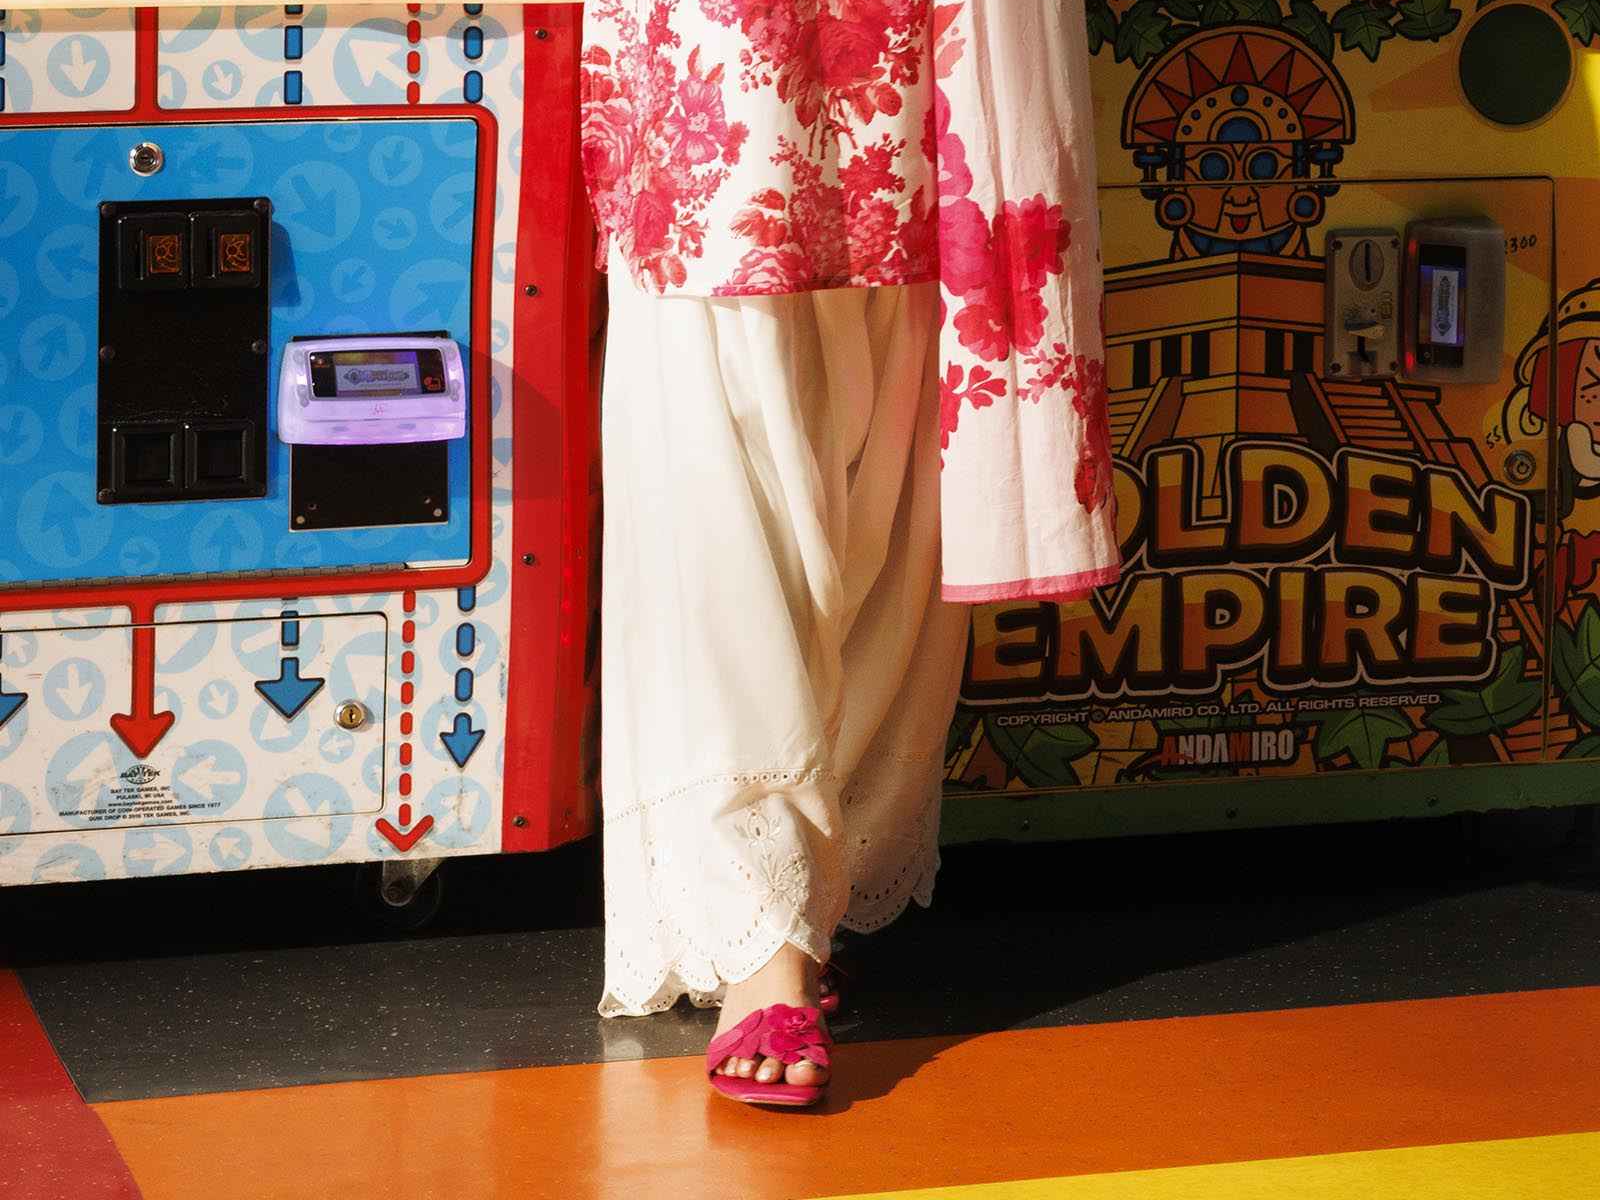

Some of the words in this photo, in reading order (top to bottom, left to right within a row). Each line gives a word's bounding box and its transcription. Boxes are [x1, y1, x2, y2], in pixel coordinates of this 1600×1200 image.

[968, 568, 1486, 686] EMPIRE
[997, 711, 1089, 727] COPYRIGHT
[1107, 705, 1193, 721] ANDAMIRO
[1230, 703, 1263, 715] LTD.
[1266, 700, 1296, 713] ALL
[1299, 697, 1356, 711] RIGHTS
[1358, 694, 1442, 708] RESERVED.
[1160, 729, 1294, 766] ANDAMIRO
